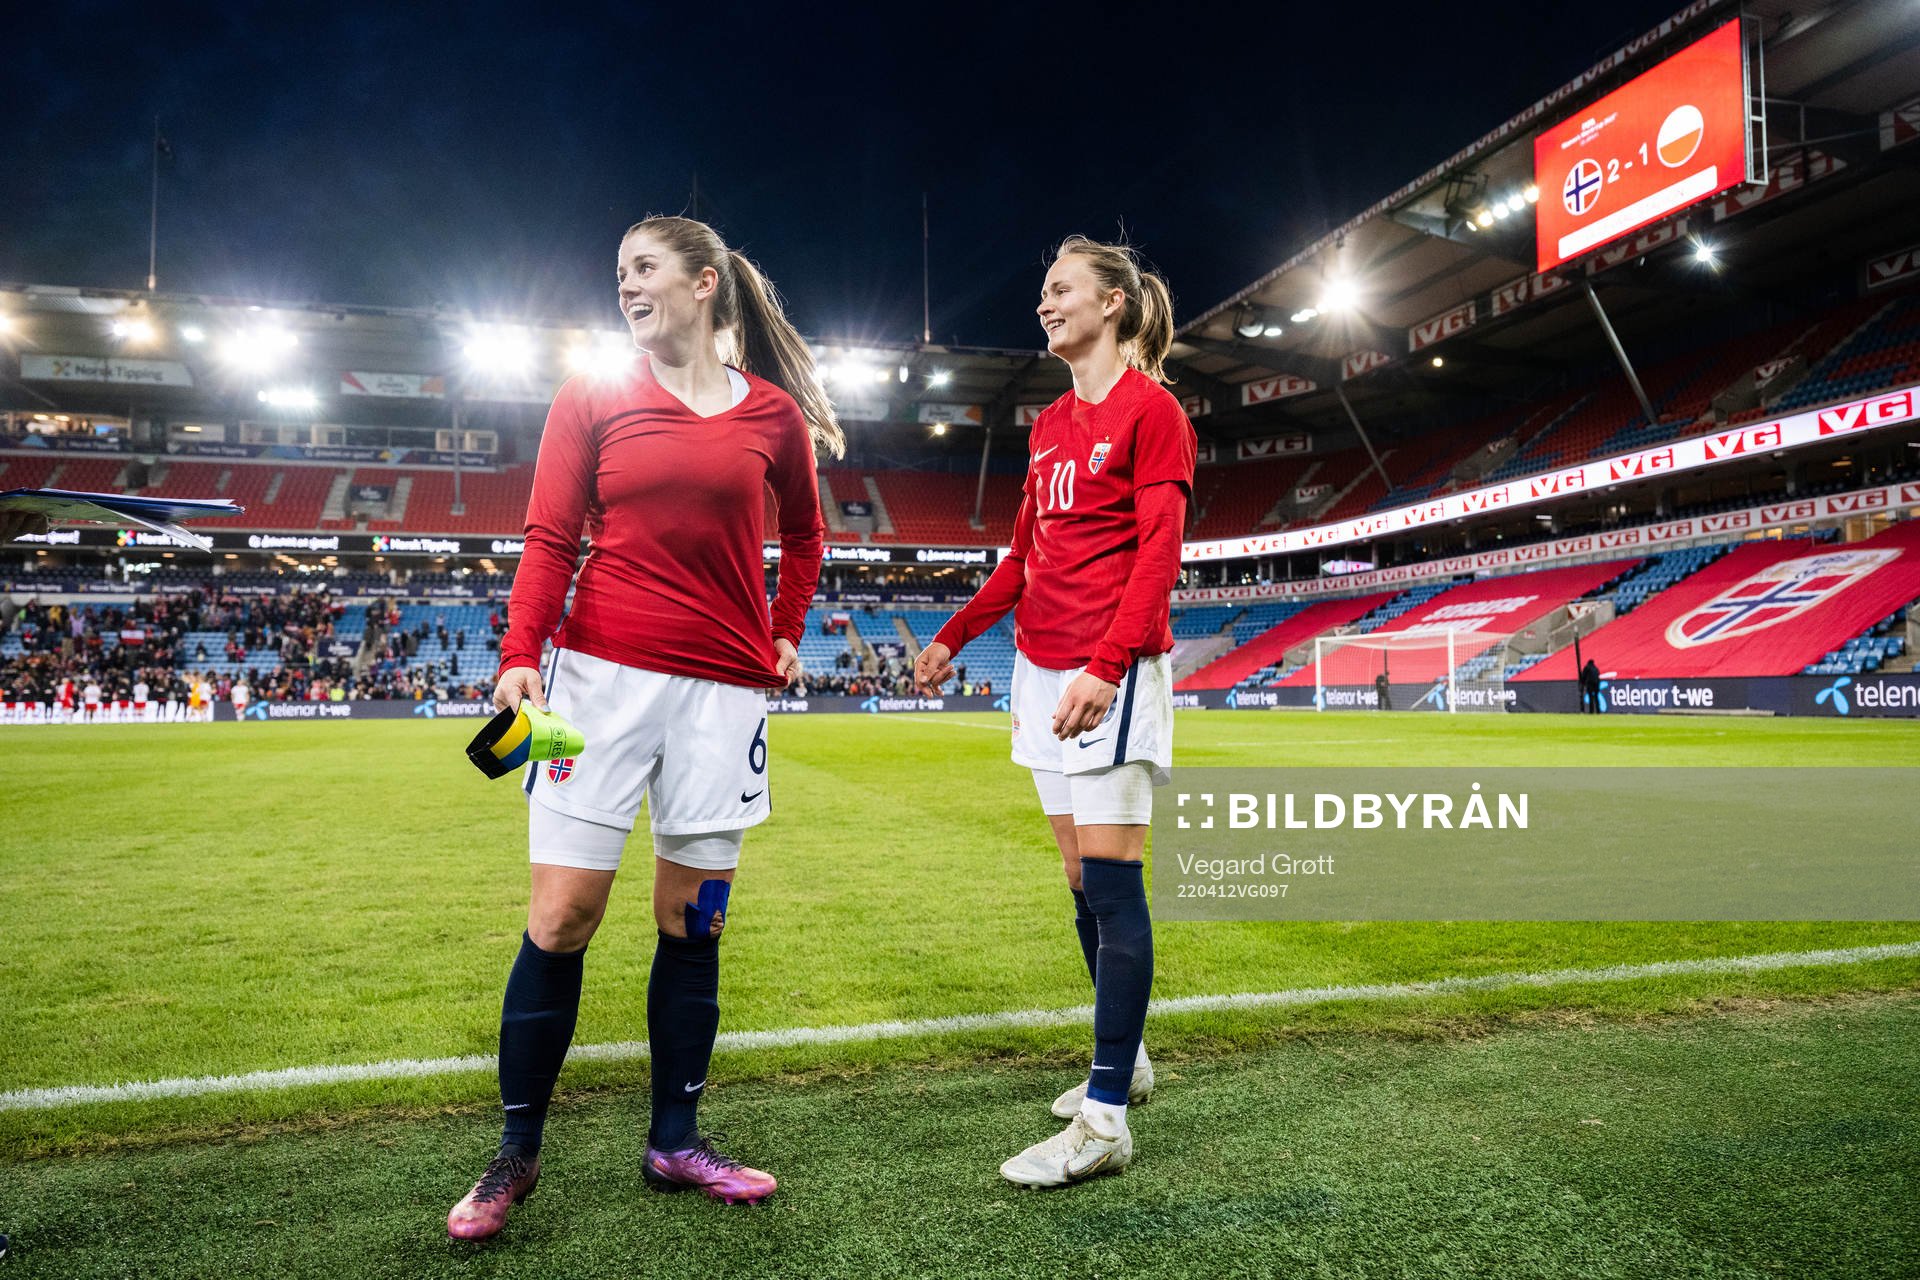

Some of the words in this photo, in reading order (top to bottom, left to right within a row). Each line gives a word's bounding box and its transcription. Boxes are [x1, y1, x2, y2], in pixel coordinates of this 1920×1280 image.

[1607, 158, 1620, 184] 2
[1638, 142, 1648, 166] 1
[1417, 312, 1471, 343] VG
[115, 365, 163, 382] Tipping
[1250, 375, 1307, 401] VG
[1248, 436, 1305, 457] VG
[1243, 535, 1286, 554] VG
[1304, 525, 1338, 546] VG
[1353, 513, 1388, 536] VG
[1404, 502, 1444, 526] VG
[1463, 486, 1509, 513] VG
[1530, 468, 1585, 498] VG
[1610, 448, 1674, 480] VG
[1704, 423, 1781, 460] VG
[1818, 391, 1912, 435] VG
[1047, 459, 1076, 511] 10
[1477, 551, 1508, 567] VG
[1515, 544, 1548, 562] VG
[1555, 537, 1592, 555] VG
[1600, 529, 1640, 549] VG
[1648, 521, 1692, 541] VG
[1702, 511, 1750, 533] VG
[1761, 500, 1815, 525] VG
[1827, 489, 1888, 514] VG
[1236, 691, 1260, 706] telenor
[1326, 688, 1355, 706] telenor
[1357, 689, 1379, 706] t-we
[1446, 687, 1485, 706] tlenor
[1488, 687, 1516, 706] t-we
[1610, 683, 1668, 706] telenor
[1672, 685, 1713, 707] t-we
[1855, 680, 1920, 707] telen
[269, 702, 317, 718] telenor
[319, 703, 351, 718] t-we
[436, 701, 482, 716] telenor
[781, 701, 808, 712] t-we
[879, 699, 915, 711] telenor
[919, 699, 944, 711] t-we
[748, 717, 767, 775] 6
